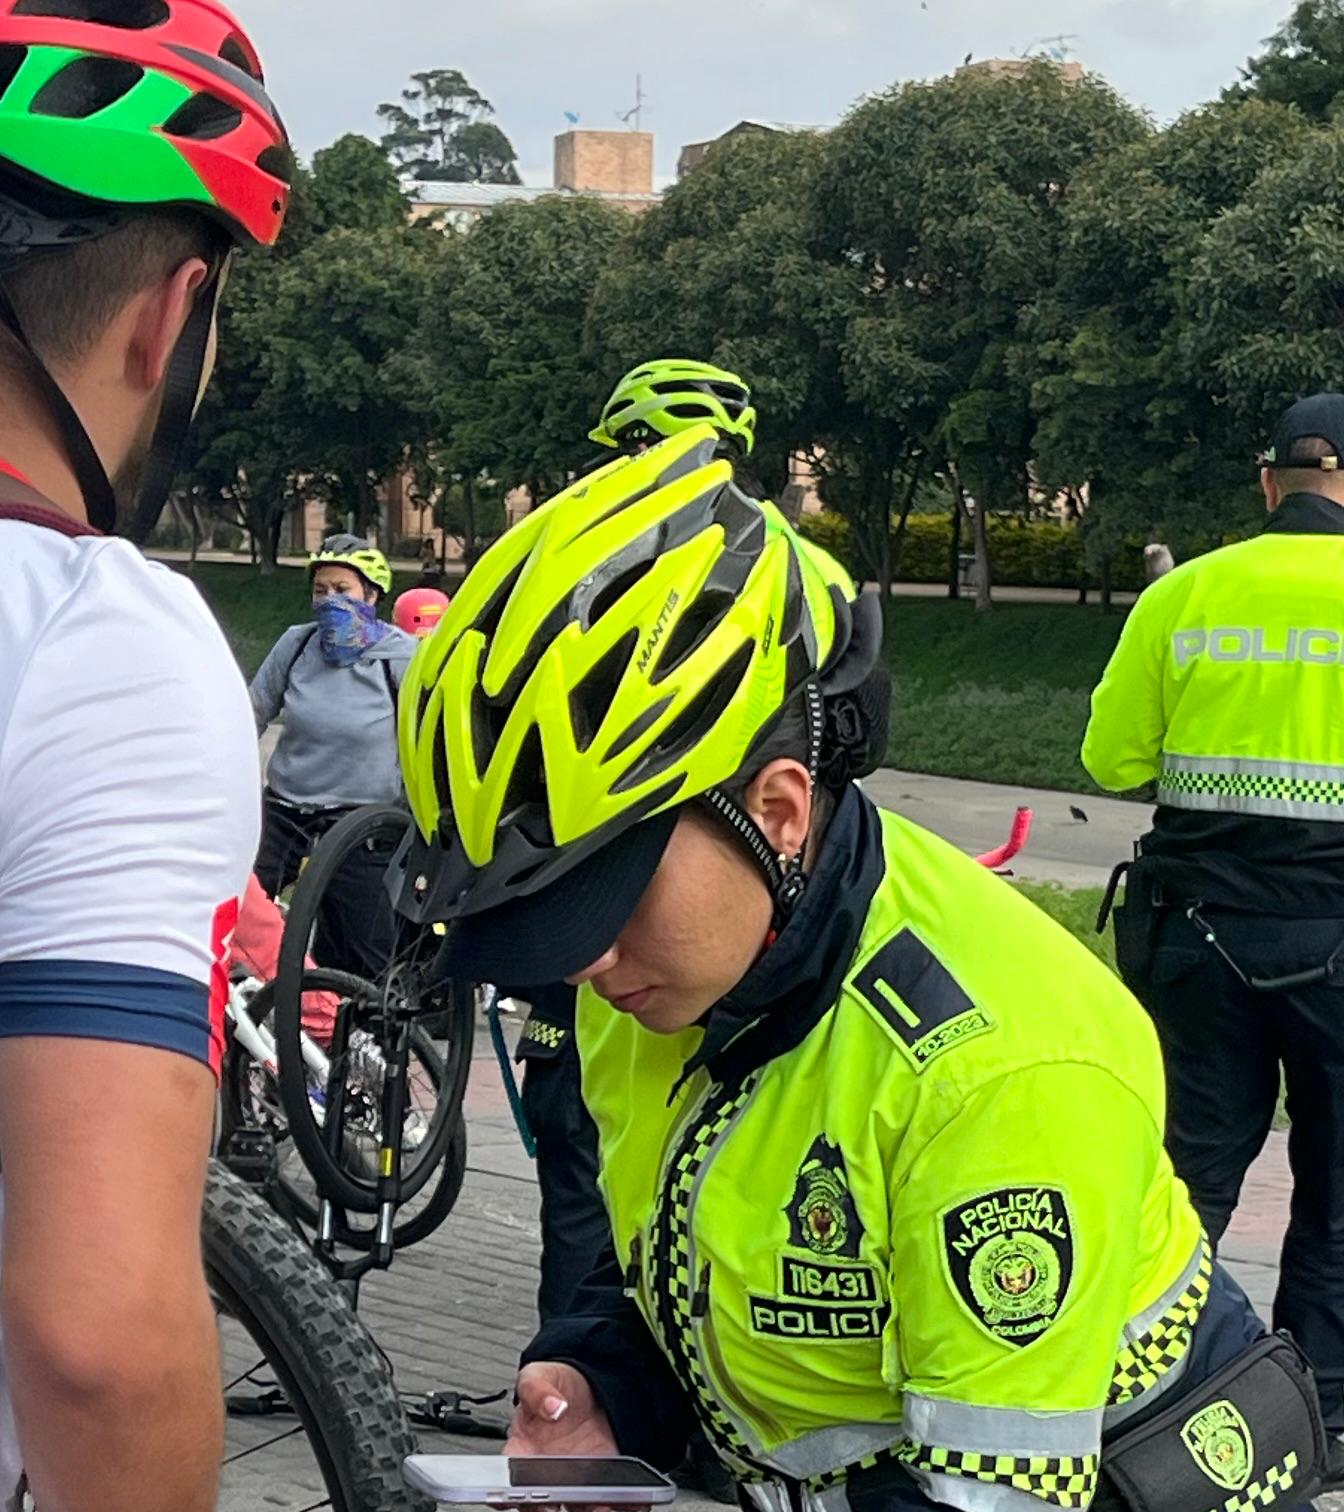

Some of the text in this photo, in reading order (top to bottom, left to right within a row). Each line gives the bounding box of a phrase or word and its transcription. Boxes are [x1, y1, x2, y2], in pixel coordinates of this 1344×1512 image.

[637, 588, 680, 673] MANTIS
[959, 1187, 1053, 1229] POLICÍA
[951, 1210, 1067, 1257] NACIONAL
[789, 1262, 870, 1298] 116431
[753, 1304, 881, 1337] POLICÍ
